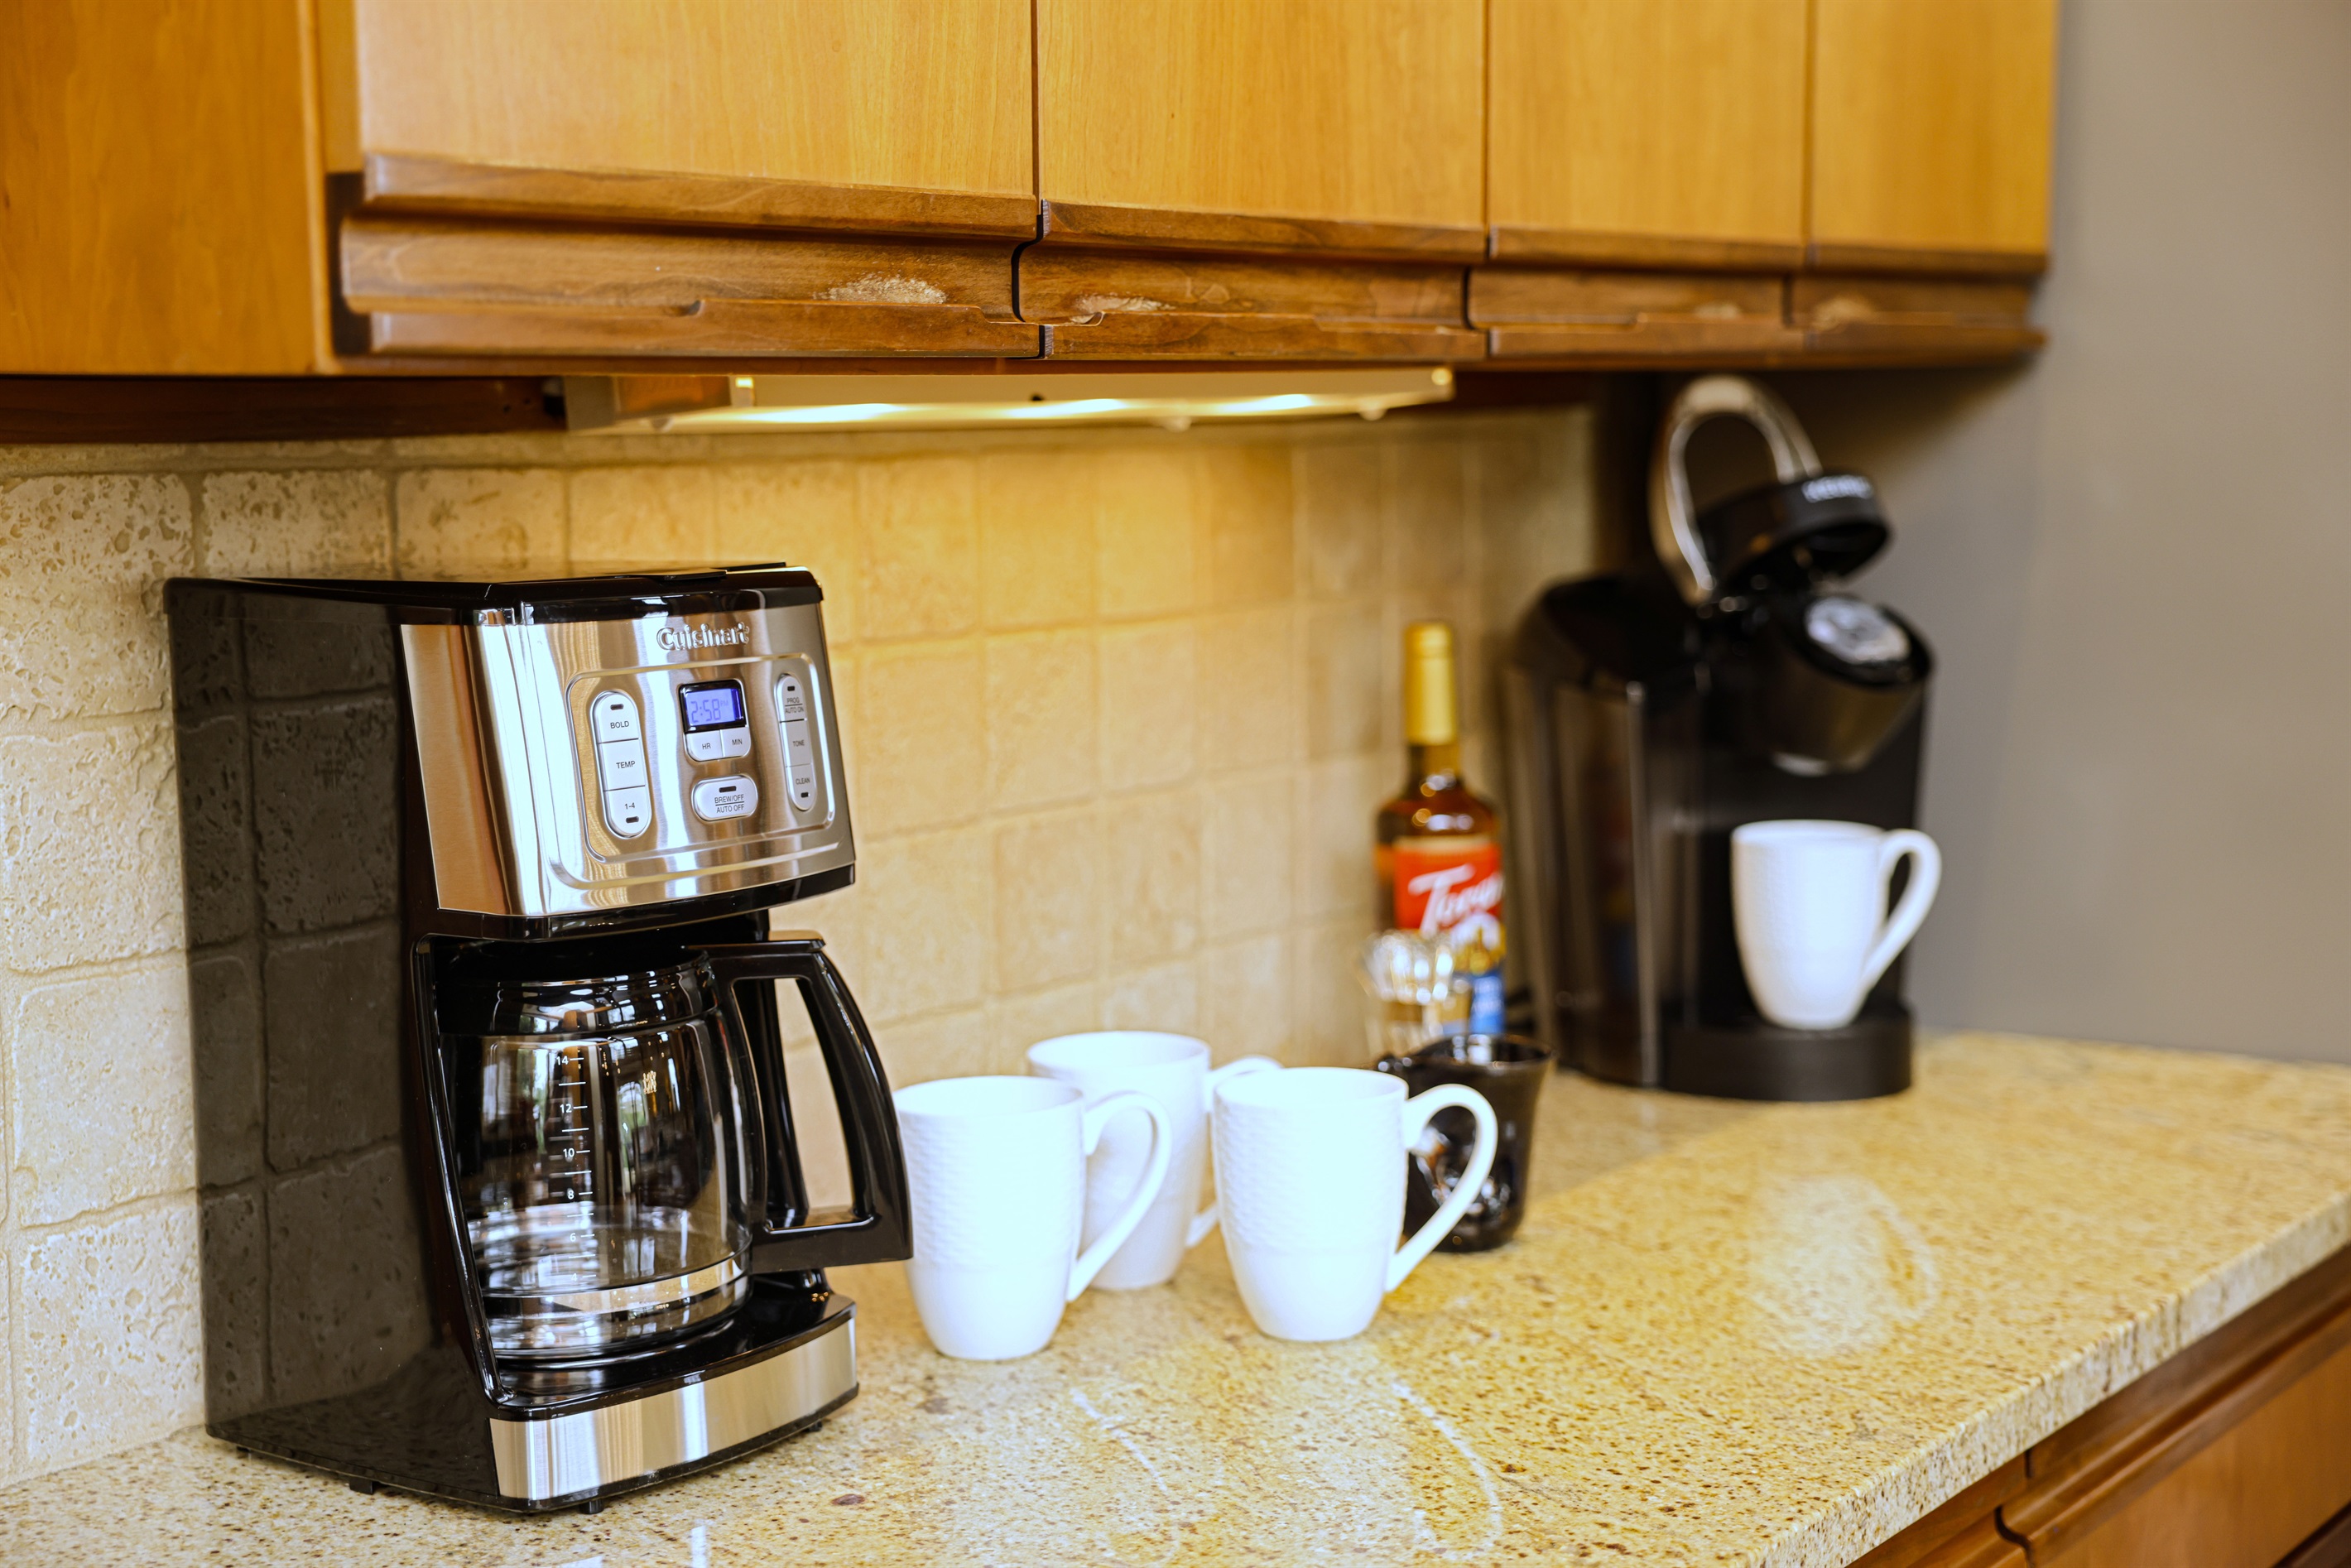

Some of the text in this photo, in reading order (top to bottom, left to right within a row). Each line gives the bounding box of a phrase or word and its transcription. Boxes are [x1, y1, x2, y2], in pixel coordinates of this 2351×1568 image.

[656, 622, 749, 650] Cuisinart
[690, 699, 721, 723] 2:58
[610, 720, 630, 729] BOLD
[732, 738, 743, 746] MIN
[616, 760, 636, 769] TEMP
[796, 777, 810, 786] CLEAN
[714, 794, 745, 804] BREW/OFF
[716, 804, 745, 814] AUTO OFF
[556, 1056, 570, 1065] 14
[560, 1103, 573, 1113] 12
[563, 1147, 575, 1158] 10
[566, 1190, 575, 1200] 8
[570, 1232, 577, 1243] 6
[570, 1272, 578, 1282] 4
